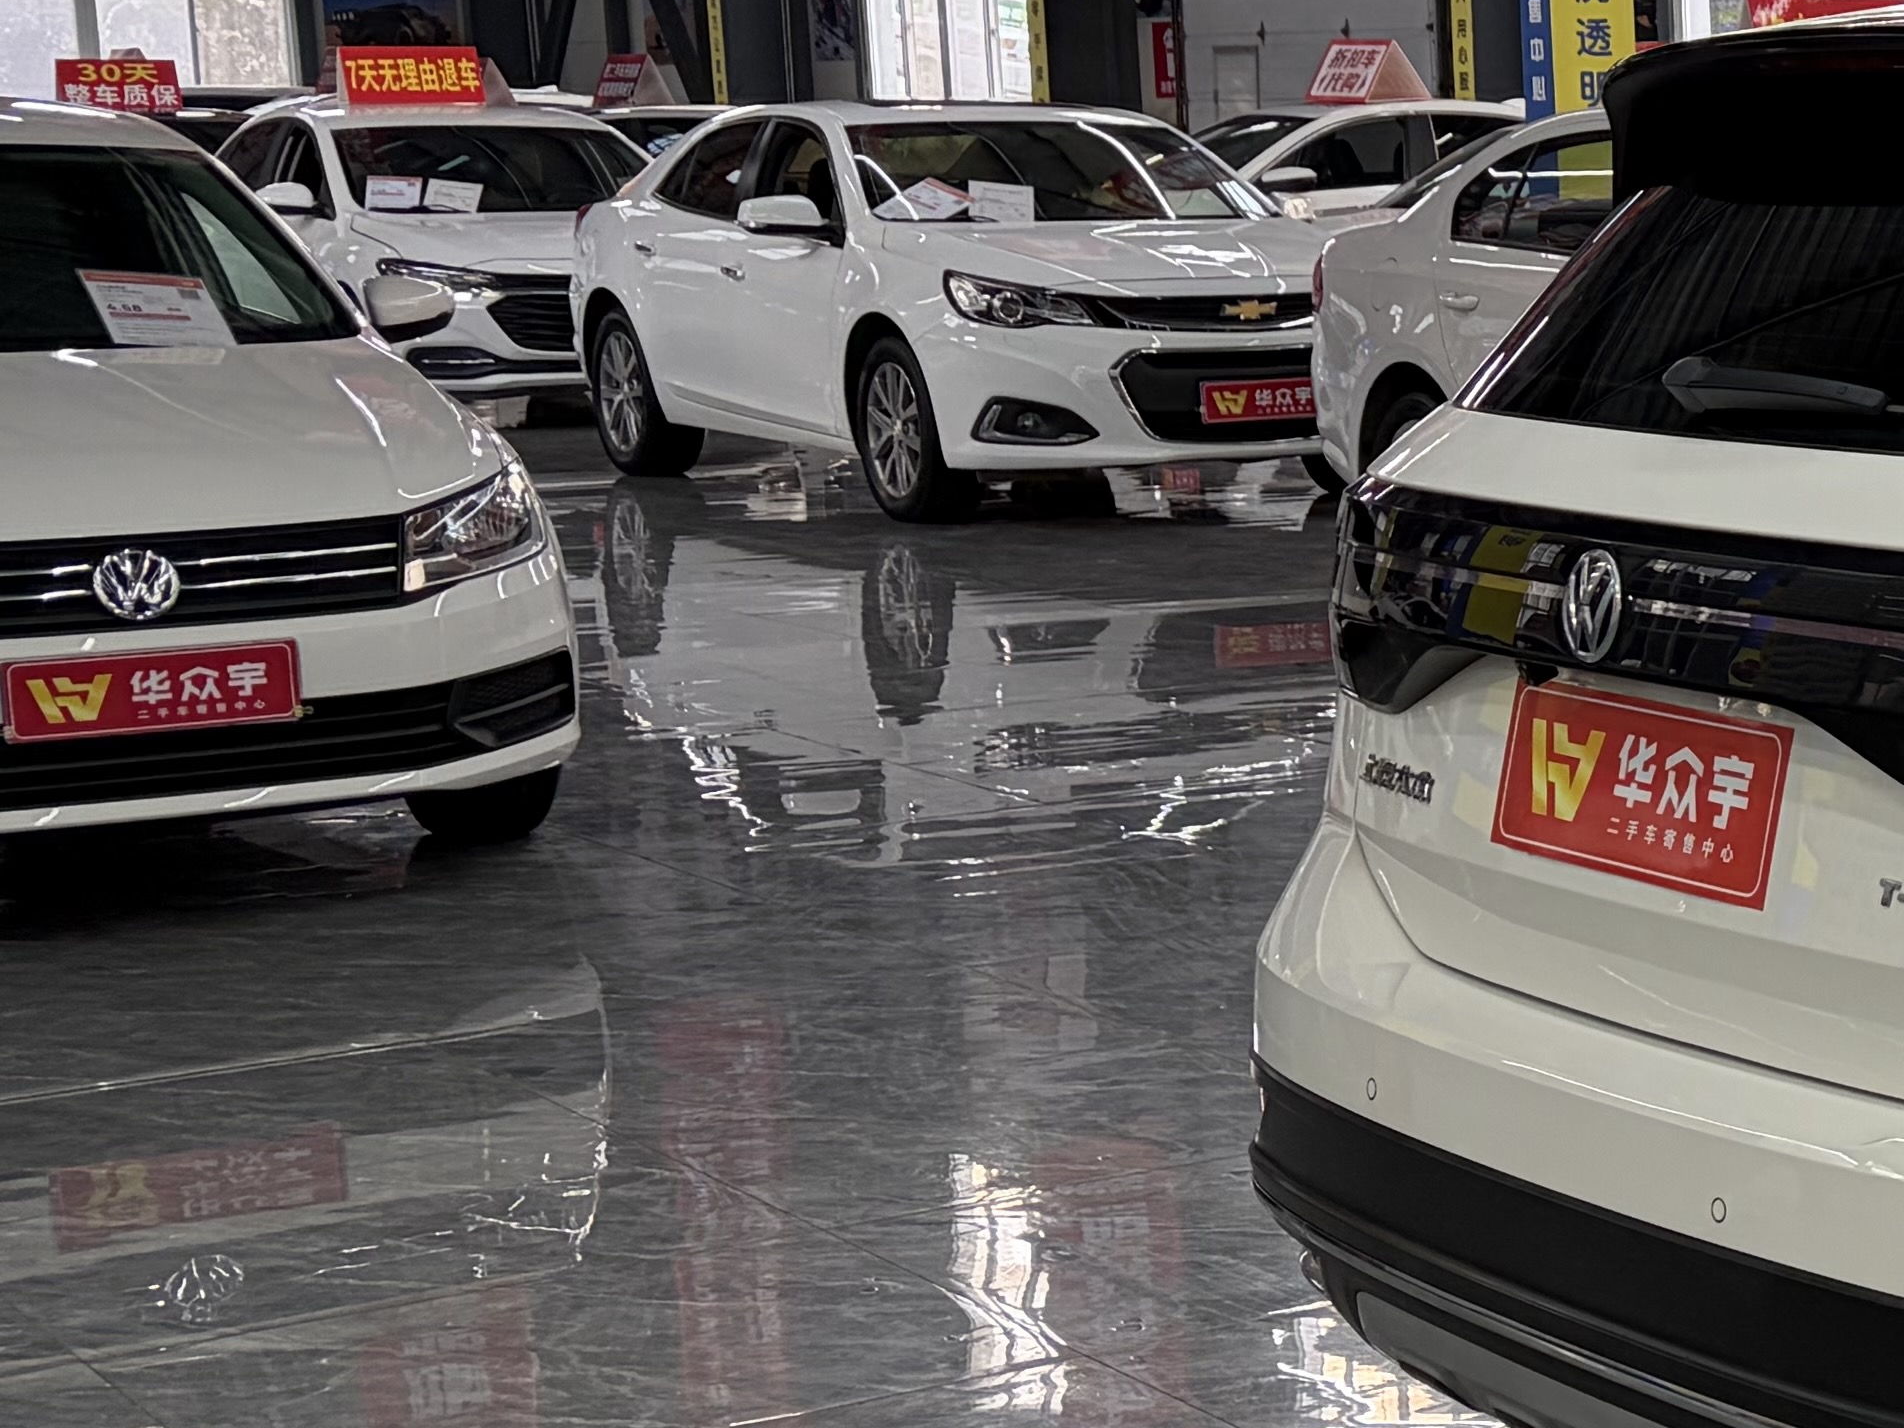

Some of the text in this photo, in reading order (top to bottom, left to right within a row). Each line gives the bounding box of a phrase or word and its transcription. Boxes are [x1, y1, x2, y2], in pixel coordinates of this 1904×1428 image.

[76, 62, 159, 84] 30天
[345, 56, 481, 93] 7天无理由退车
[63, 83, 179, 106] 整车质保
[1254, 386, 1312, 407] 华众宇
[130, 661, 268, 705] 华众宇
[1612, 733, 1754, 830] 华众宇
[1606, 817, 1734, 863] 二手车寄售中心
